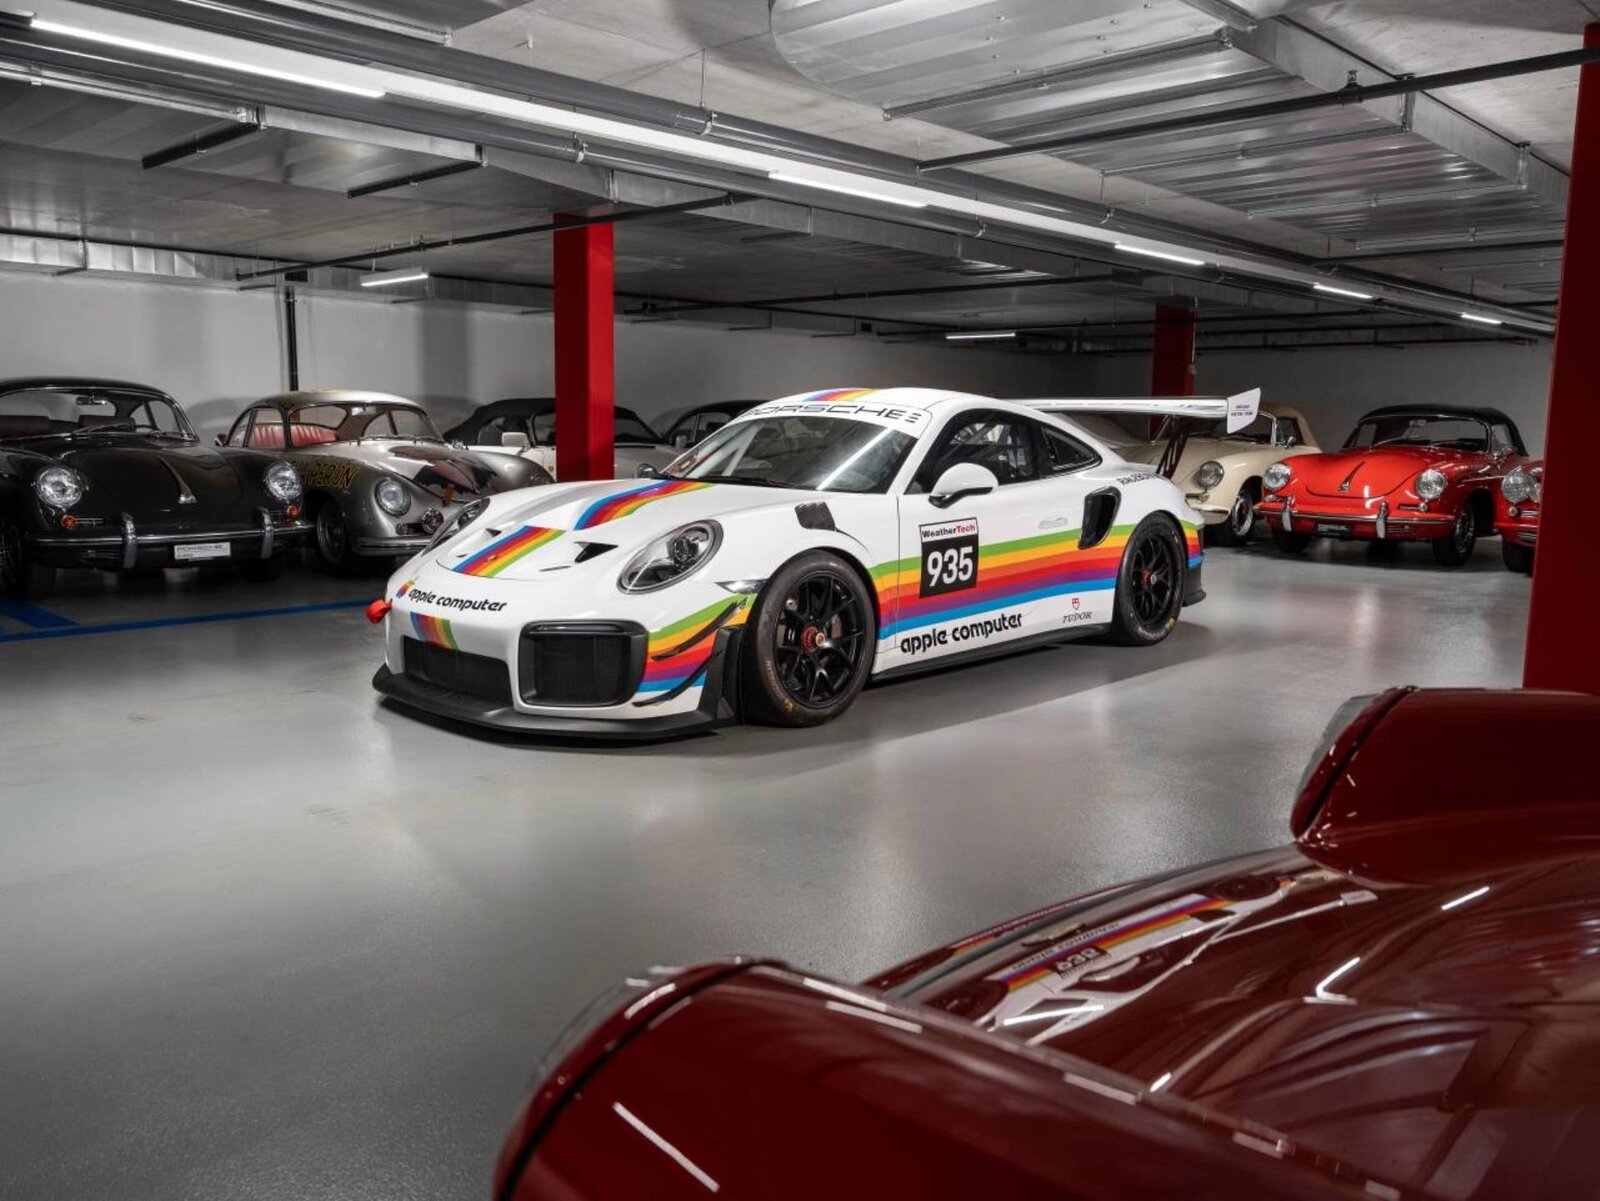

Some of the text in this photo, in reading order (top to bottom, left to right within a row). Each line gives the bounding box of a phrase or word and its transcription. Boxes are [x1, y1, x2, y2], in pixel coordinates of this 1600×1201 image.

[921, 524, 976, 538] WeatherTech
[926, 546, 974, 587] 935
[408, 588, 507, 612] apple computer
[1062, 612, 1092, 623] TUDOR
[900, 613, 1023, 655] apple computer
